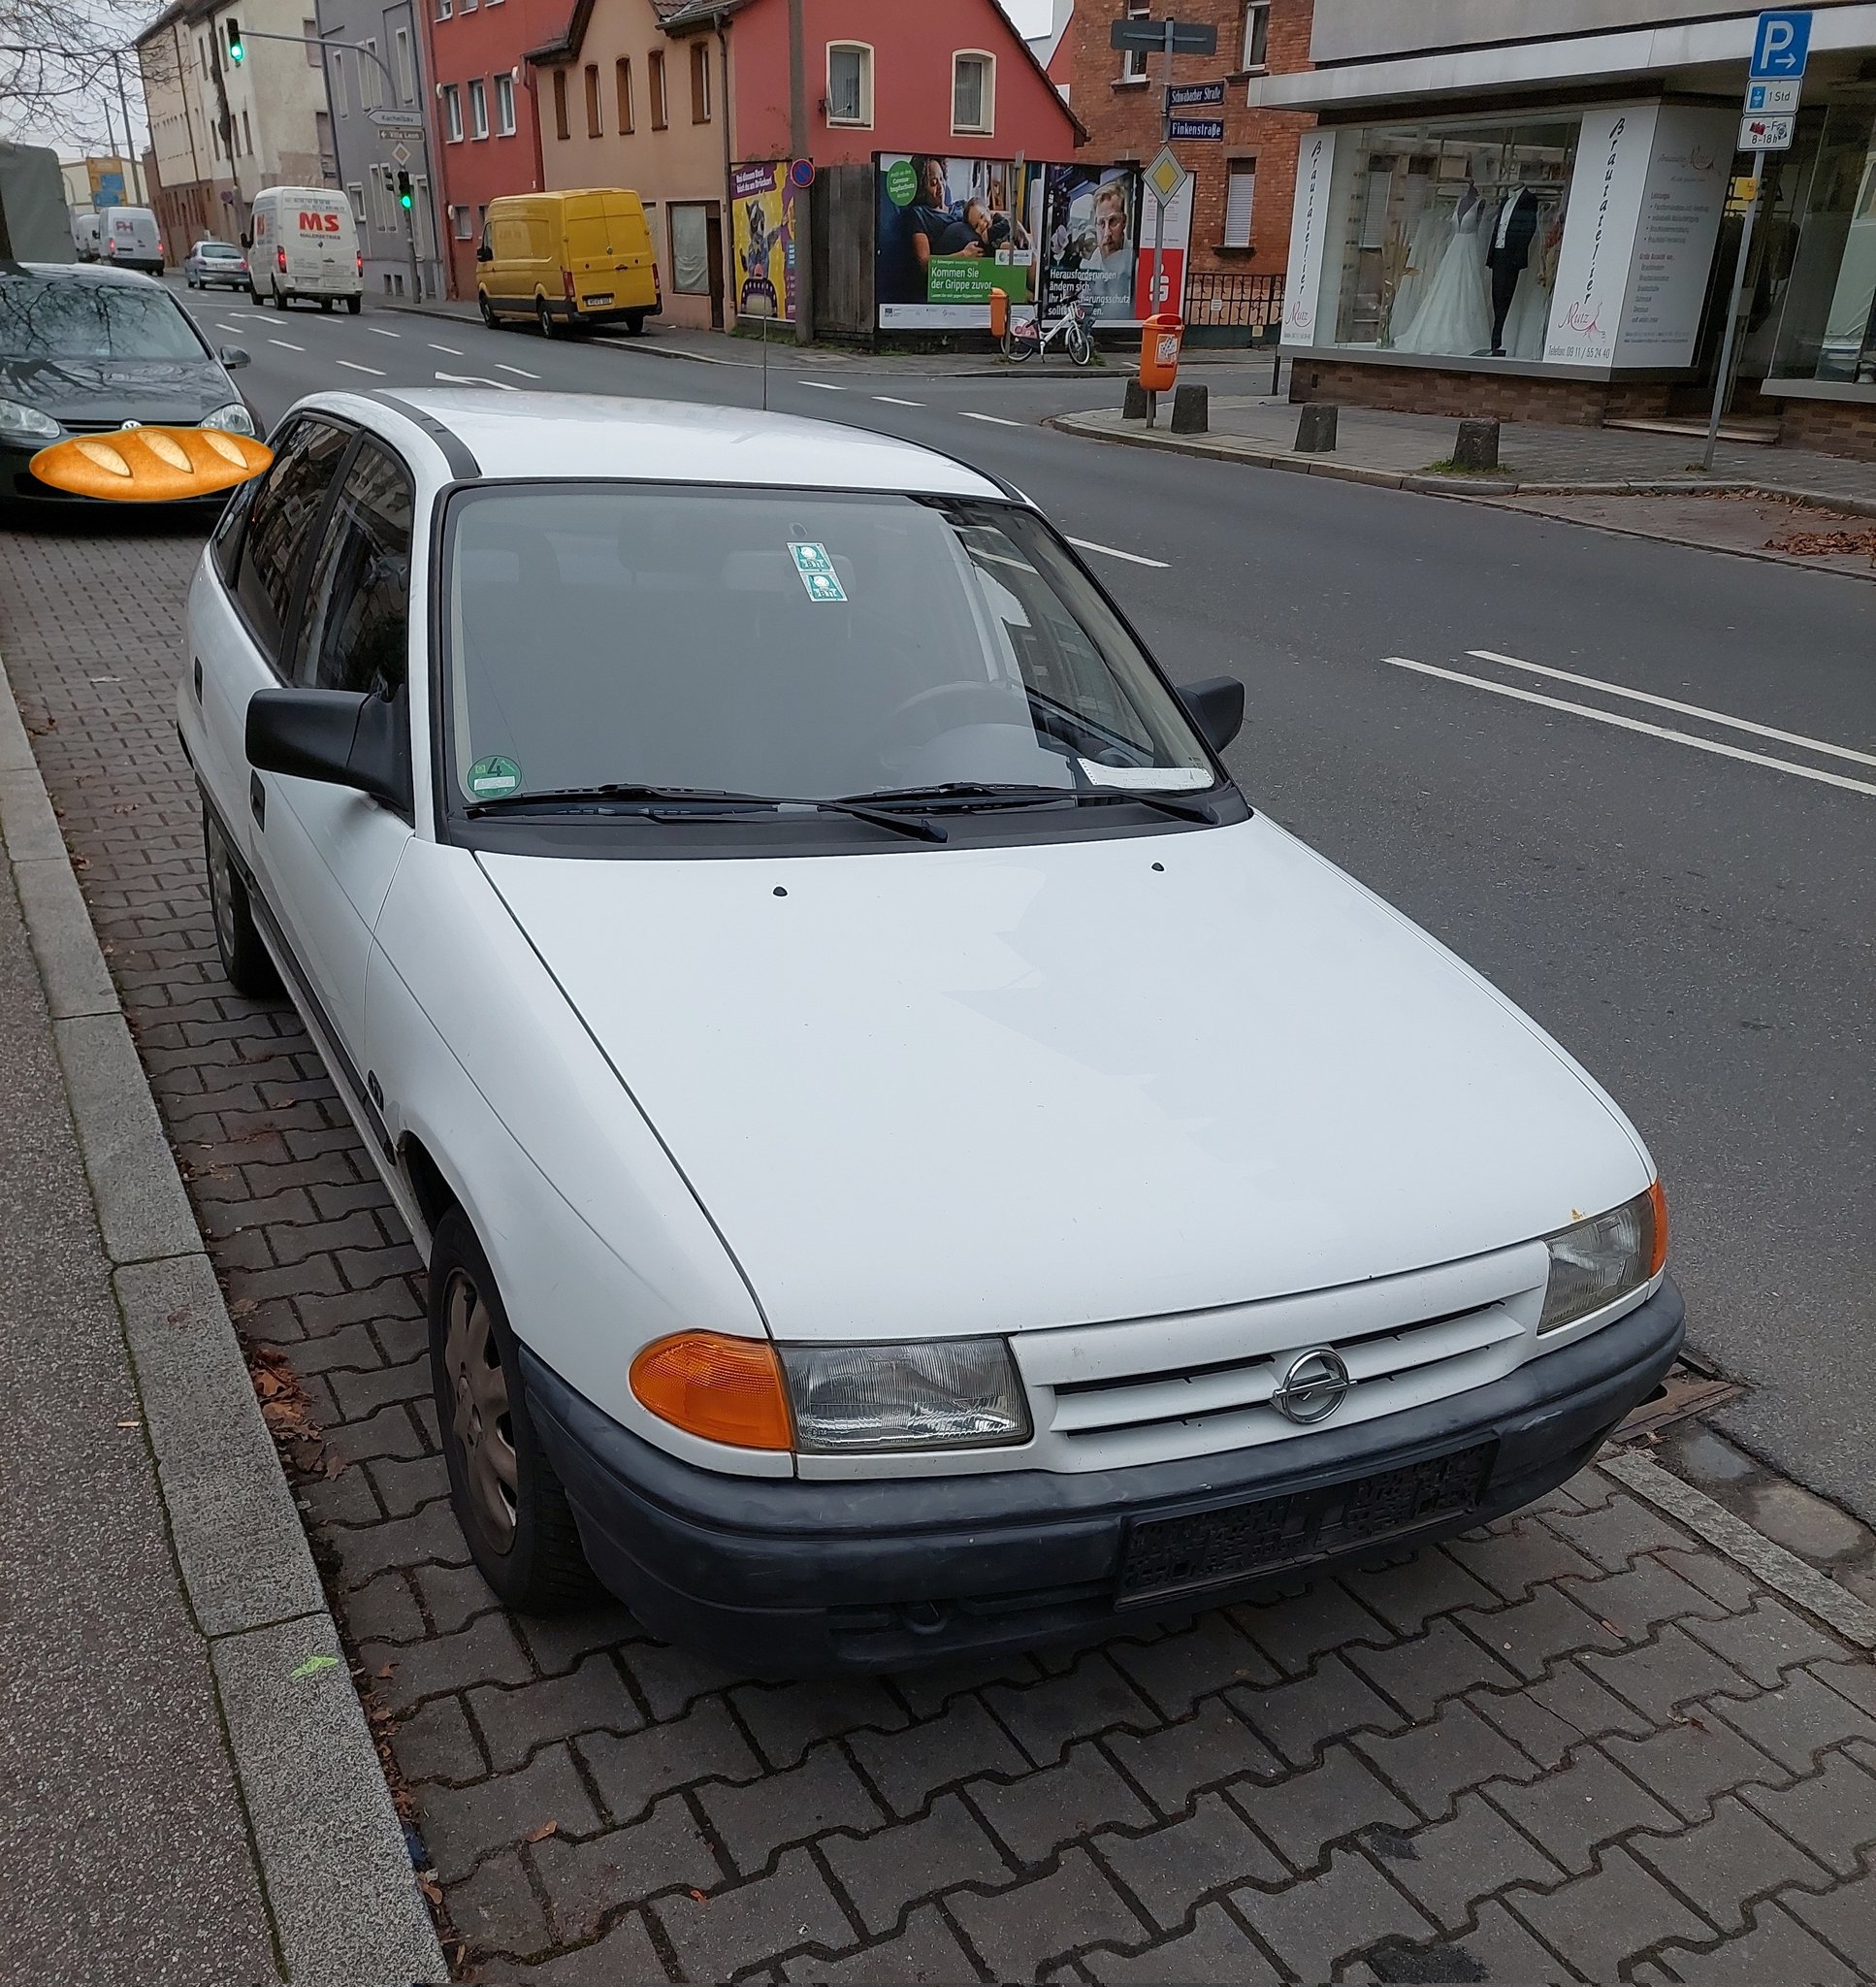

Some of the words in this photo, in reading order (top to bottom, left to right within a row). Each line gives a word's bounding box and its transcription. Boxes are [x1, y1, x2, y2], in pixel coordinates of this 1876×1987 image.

[1760, 20, 1795, 69] P
[1171, 88, 1203, 103] Schwabacher
[1203, 85, 1221, 101] Straße
[1774, 91, 1791, 102] Std
[1172, 121, 1222, 138] Finkenstraße
[1299, 140, 1323, 296] Brautatelier
[1583, 117, 1626, 305] Brautatelier
[299, 212, 340, 232] MS
[931, 267, 966, 278] Kommen
[967, 268, 980, 278] Sie
[1050, 269, 1116, 281] Herausforderungen
[931, 278, 944, 289] der
[945, 278, 970, 292] Grippe
[971, 281, 993, 290] zuvor.
[1049, 280, 1075, 291] ändern
[1075, 280, 1092, 291] sich.
[1048, 293, 1059, 304] Ihr
[1566, 345, 1574, 357] 09
[1586, 347, 1594, 358] 55
[487, 758, 502, 777] 4
